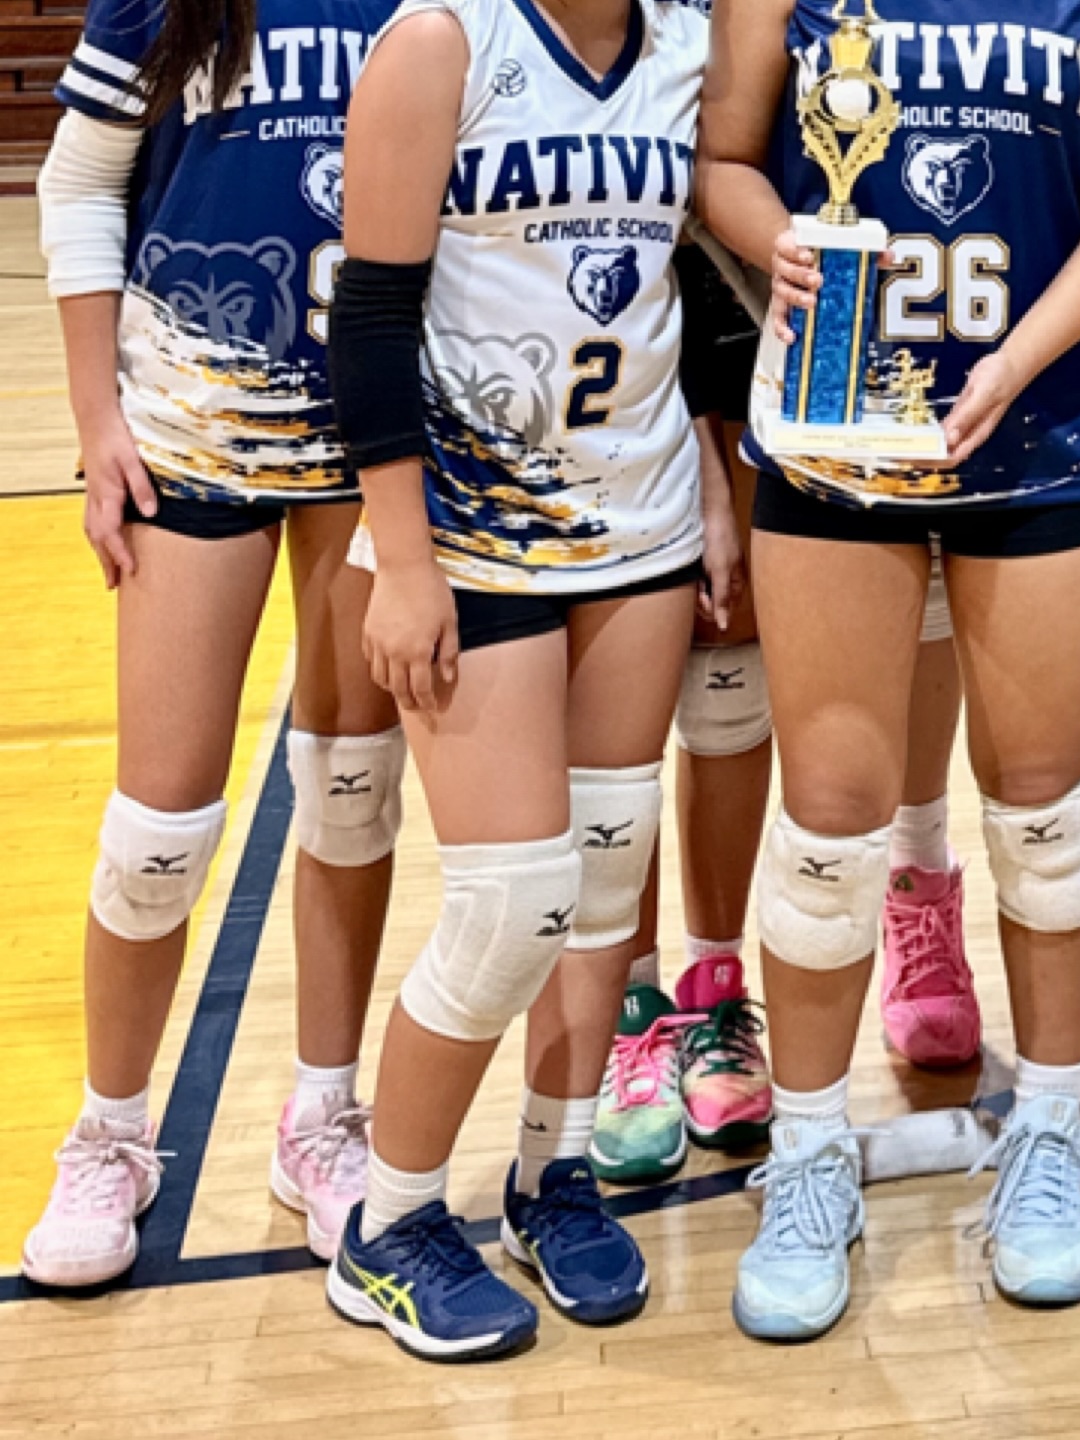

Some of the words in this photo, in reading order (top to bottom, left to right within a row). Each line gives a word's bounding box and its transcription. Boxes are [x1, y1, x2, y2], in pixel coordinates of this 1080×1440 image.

[958, 107, 1034, 136] SCHOOL
[524, 217, 612, 244] CATHOLIC
[617, 217, 674, 244] SCHOOL
[880, 233, 1011, 343] 26
[561, 335, 627, 436] 2
